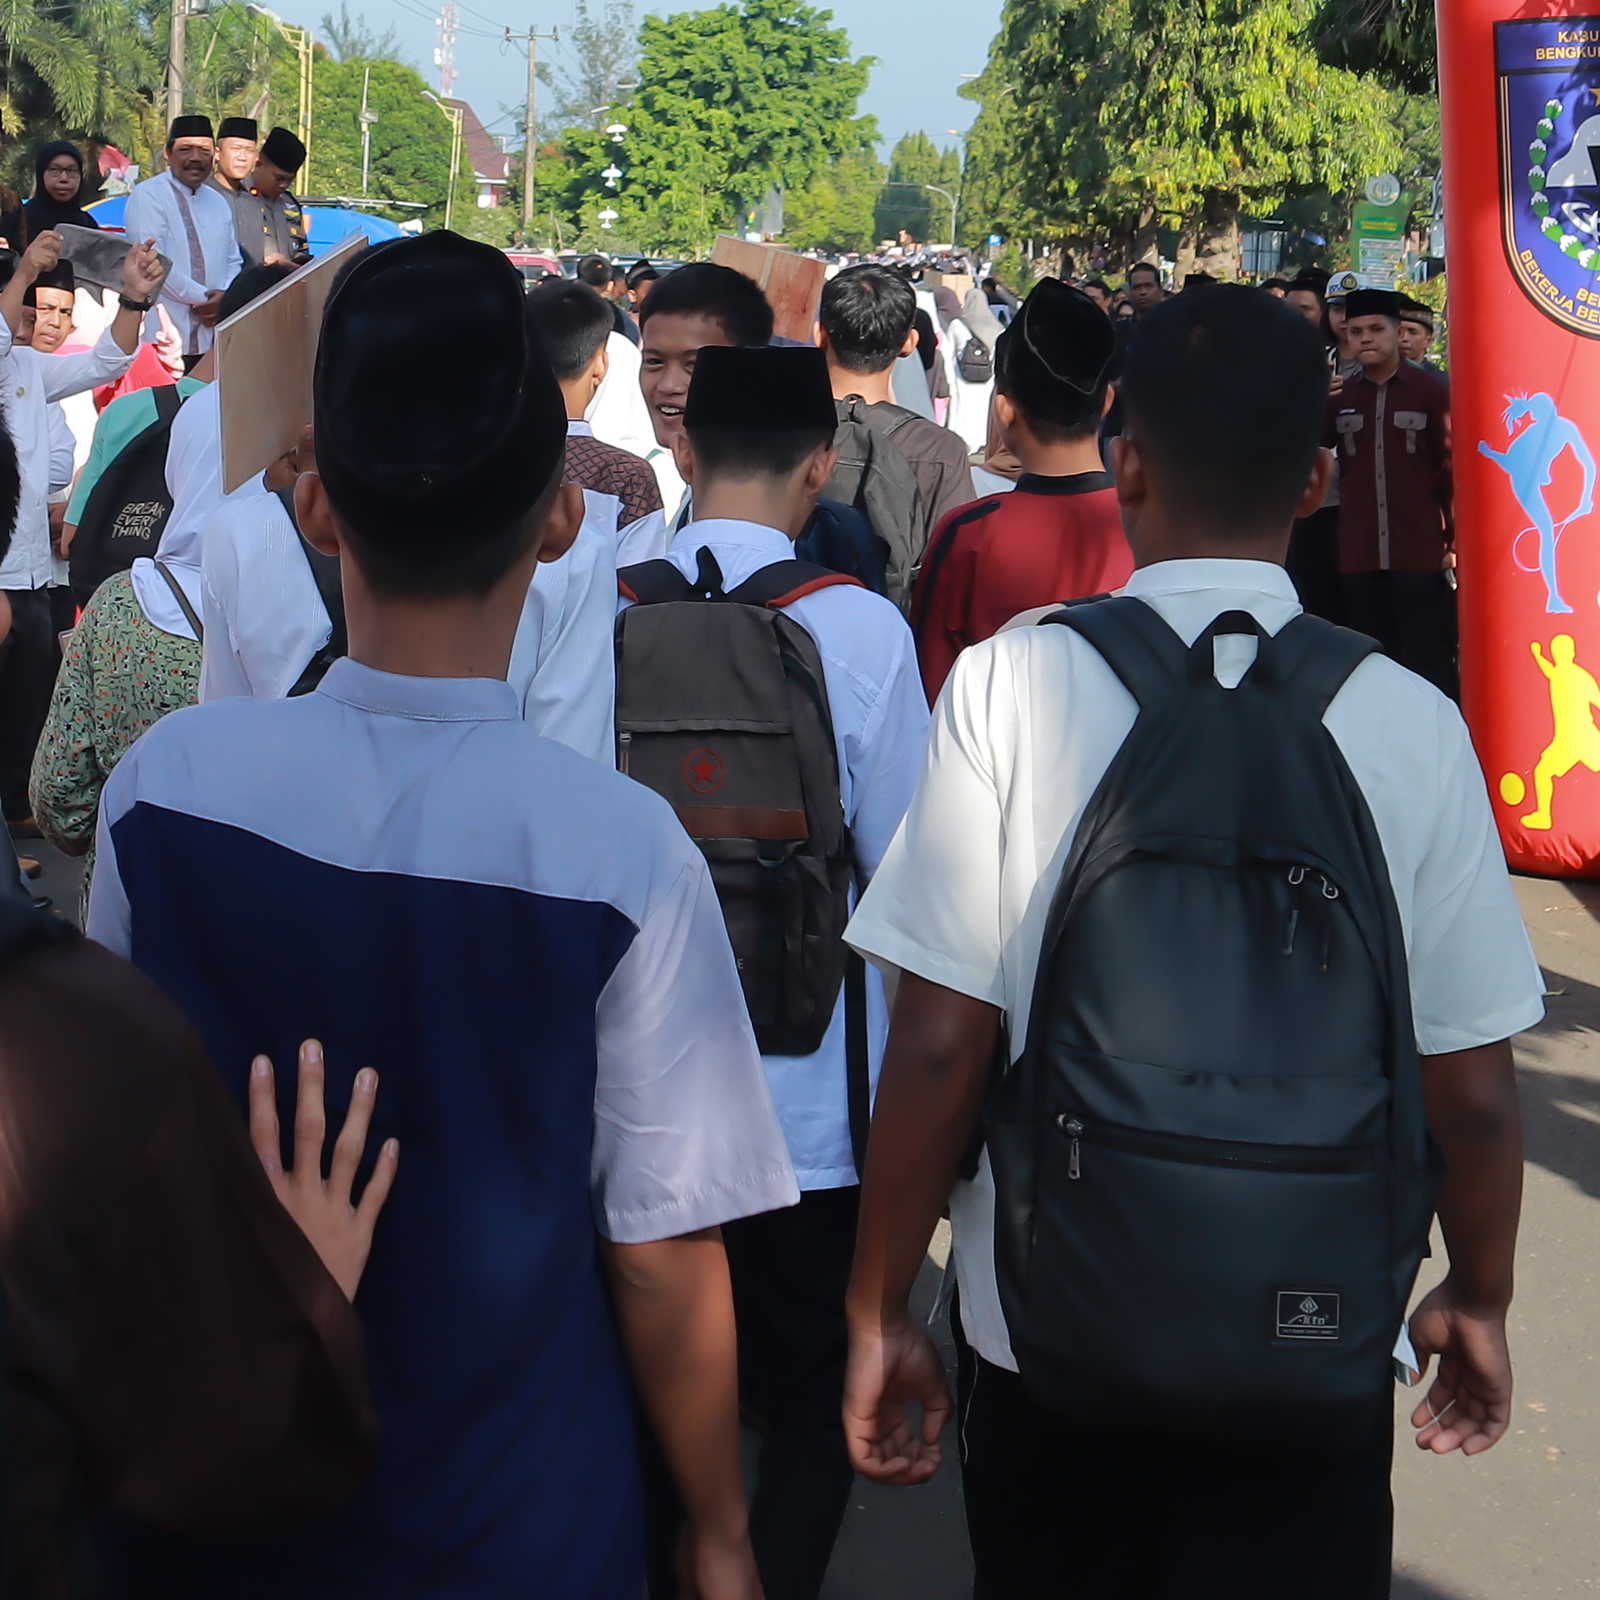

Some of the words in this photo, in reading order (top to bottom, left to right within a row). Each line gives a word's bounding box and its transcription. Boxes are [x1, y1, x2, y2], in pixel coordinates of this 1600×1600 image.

[1520, 249, 1575, 313] BEKERJA
[121, 501, 166, 519] BREAK
[115, 513, 158, 528] EVERY
[111, 524, 152, 541] THING
